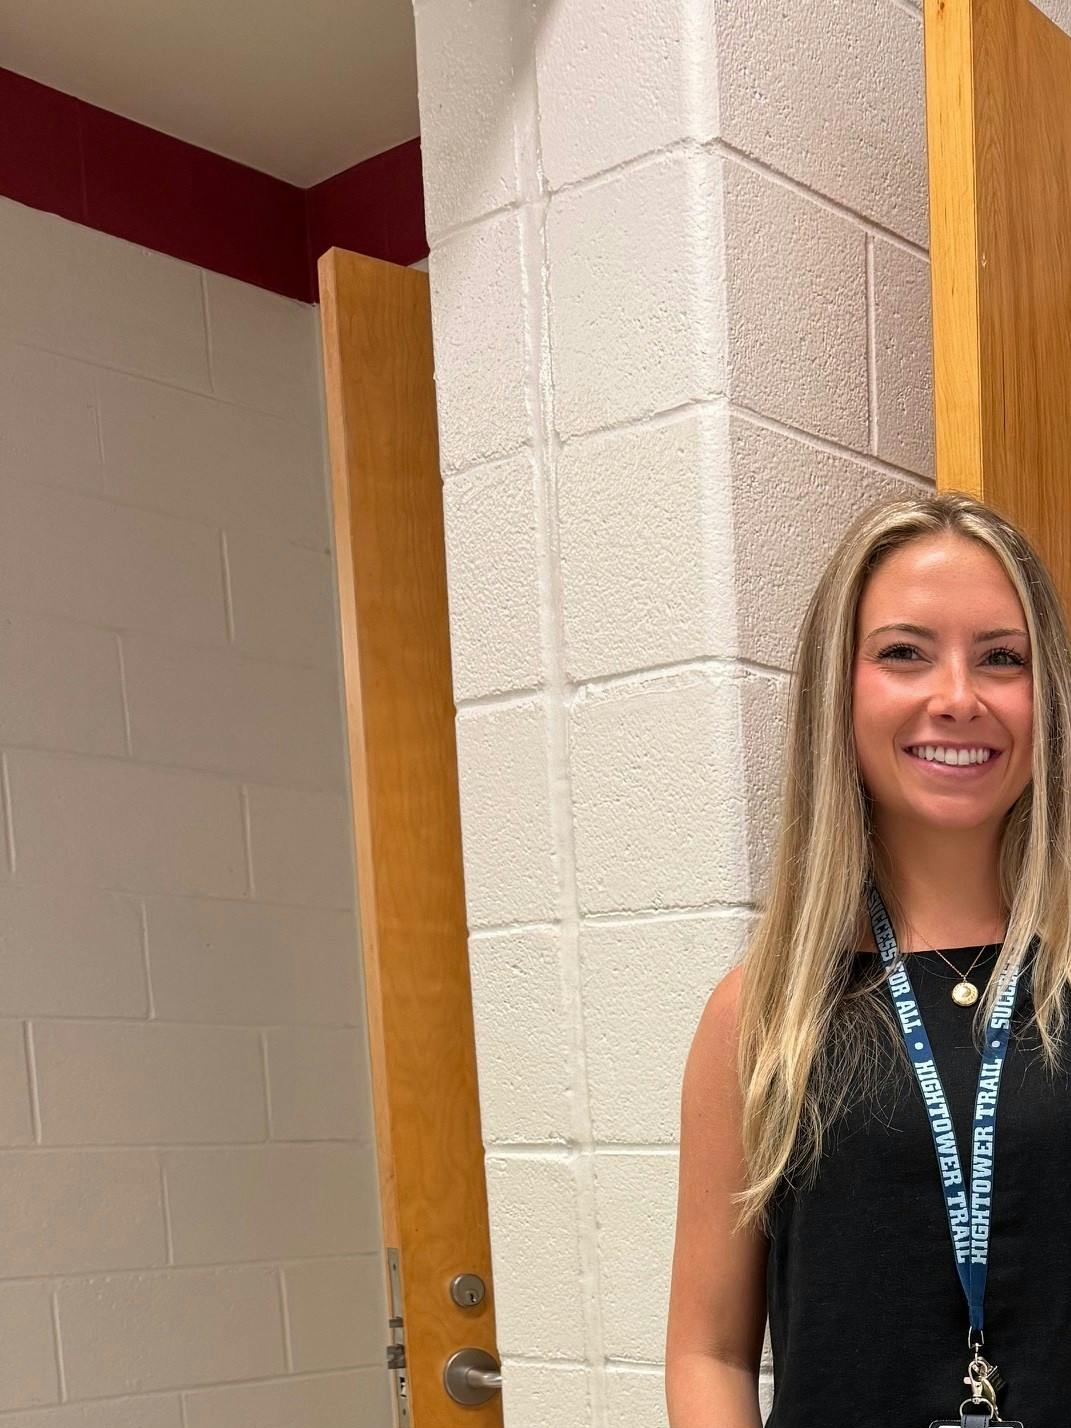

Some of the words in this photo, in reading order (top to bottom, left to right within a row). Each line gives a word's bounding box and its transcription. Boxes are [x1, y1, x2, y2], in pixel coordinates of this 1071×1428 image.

[896, 1000, 922, 1034] ALL
[990, 963, 1020, 1030] SUCCE
[975, 1058, 1003, 1121] TRAIL
[914, 1060, 963, 1188] HIGHTOWER
[946, 1190, 971, 1264] TRAIL
[971, 1125, 994, 1266] HIGHTOWER
